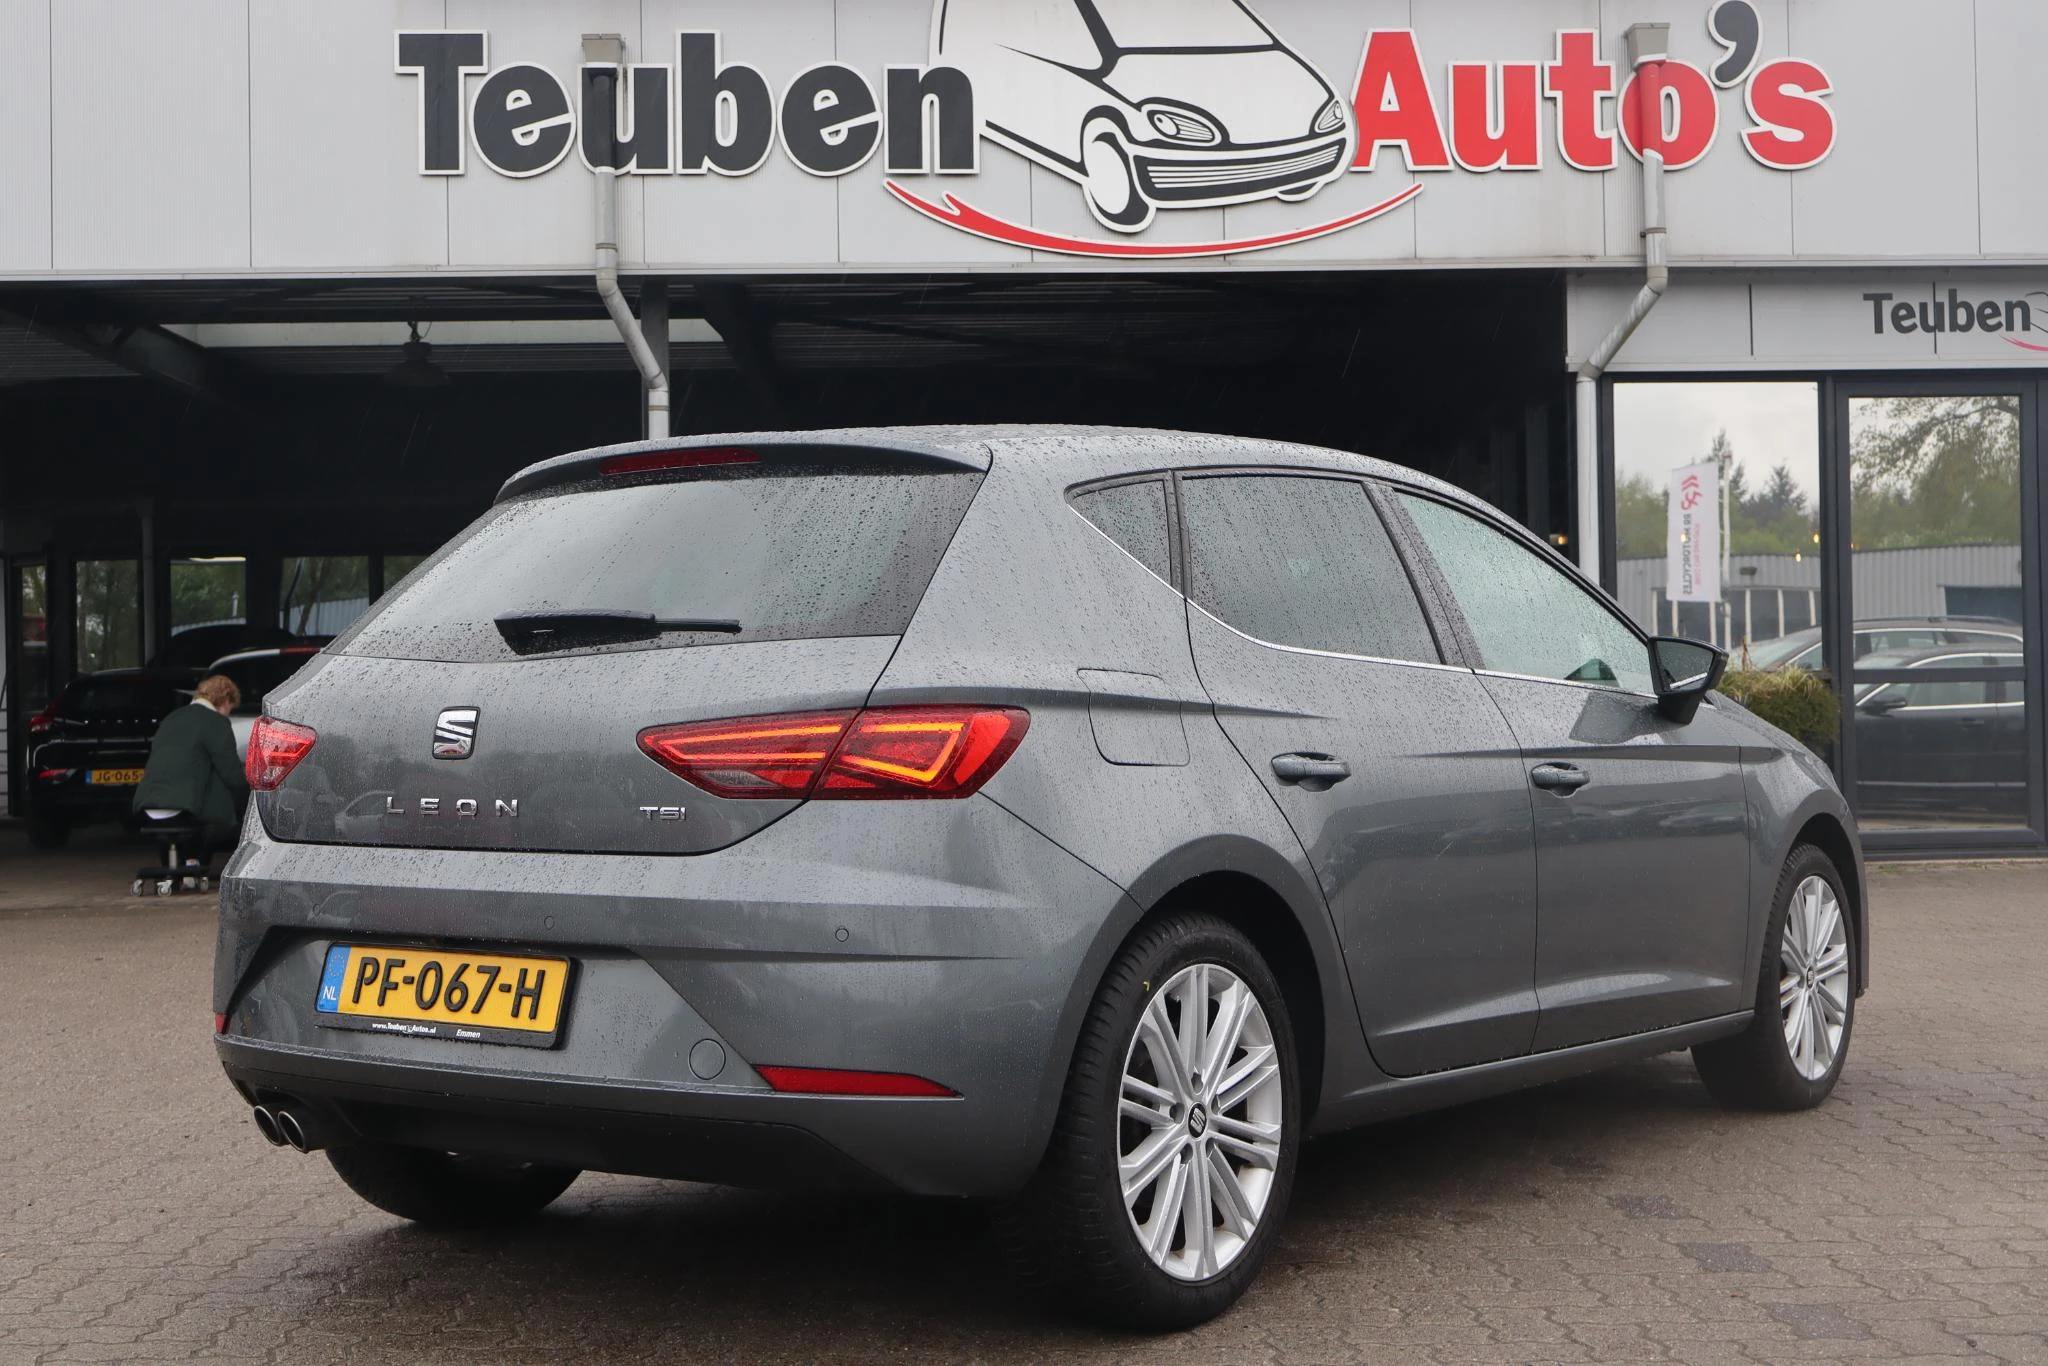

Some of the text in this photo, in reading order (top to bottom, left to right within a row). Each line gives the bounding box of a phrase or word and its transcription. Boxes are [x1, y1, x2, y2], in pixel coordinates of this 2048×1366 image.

[397, 0, 1836, 176] Teuben Auto's
[1863, 288, 2031, 334] Teuben
[386, 796, 519, 817] LEON
[639, 805, 687, 820] TSI
[322, 985, 337, 1001] NL
[351, 956, 546, 1020] PF-067-H
[456, 1028, 481, 1039] Emmen
